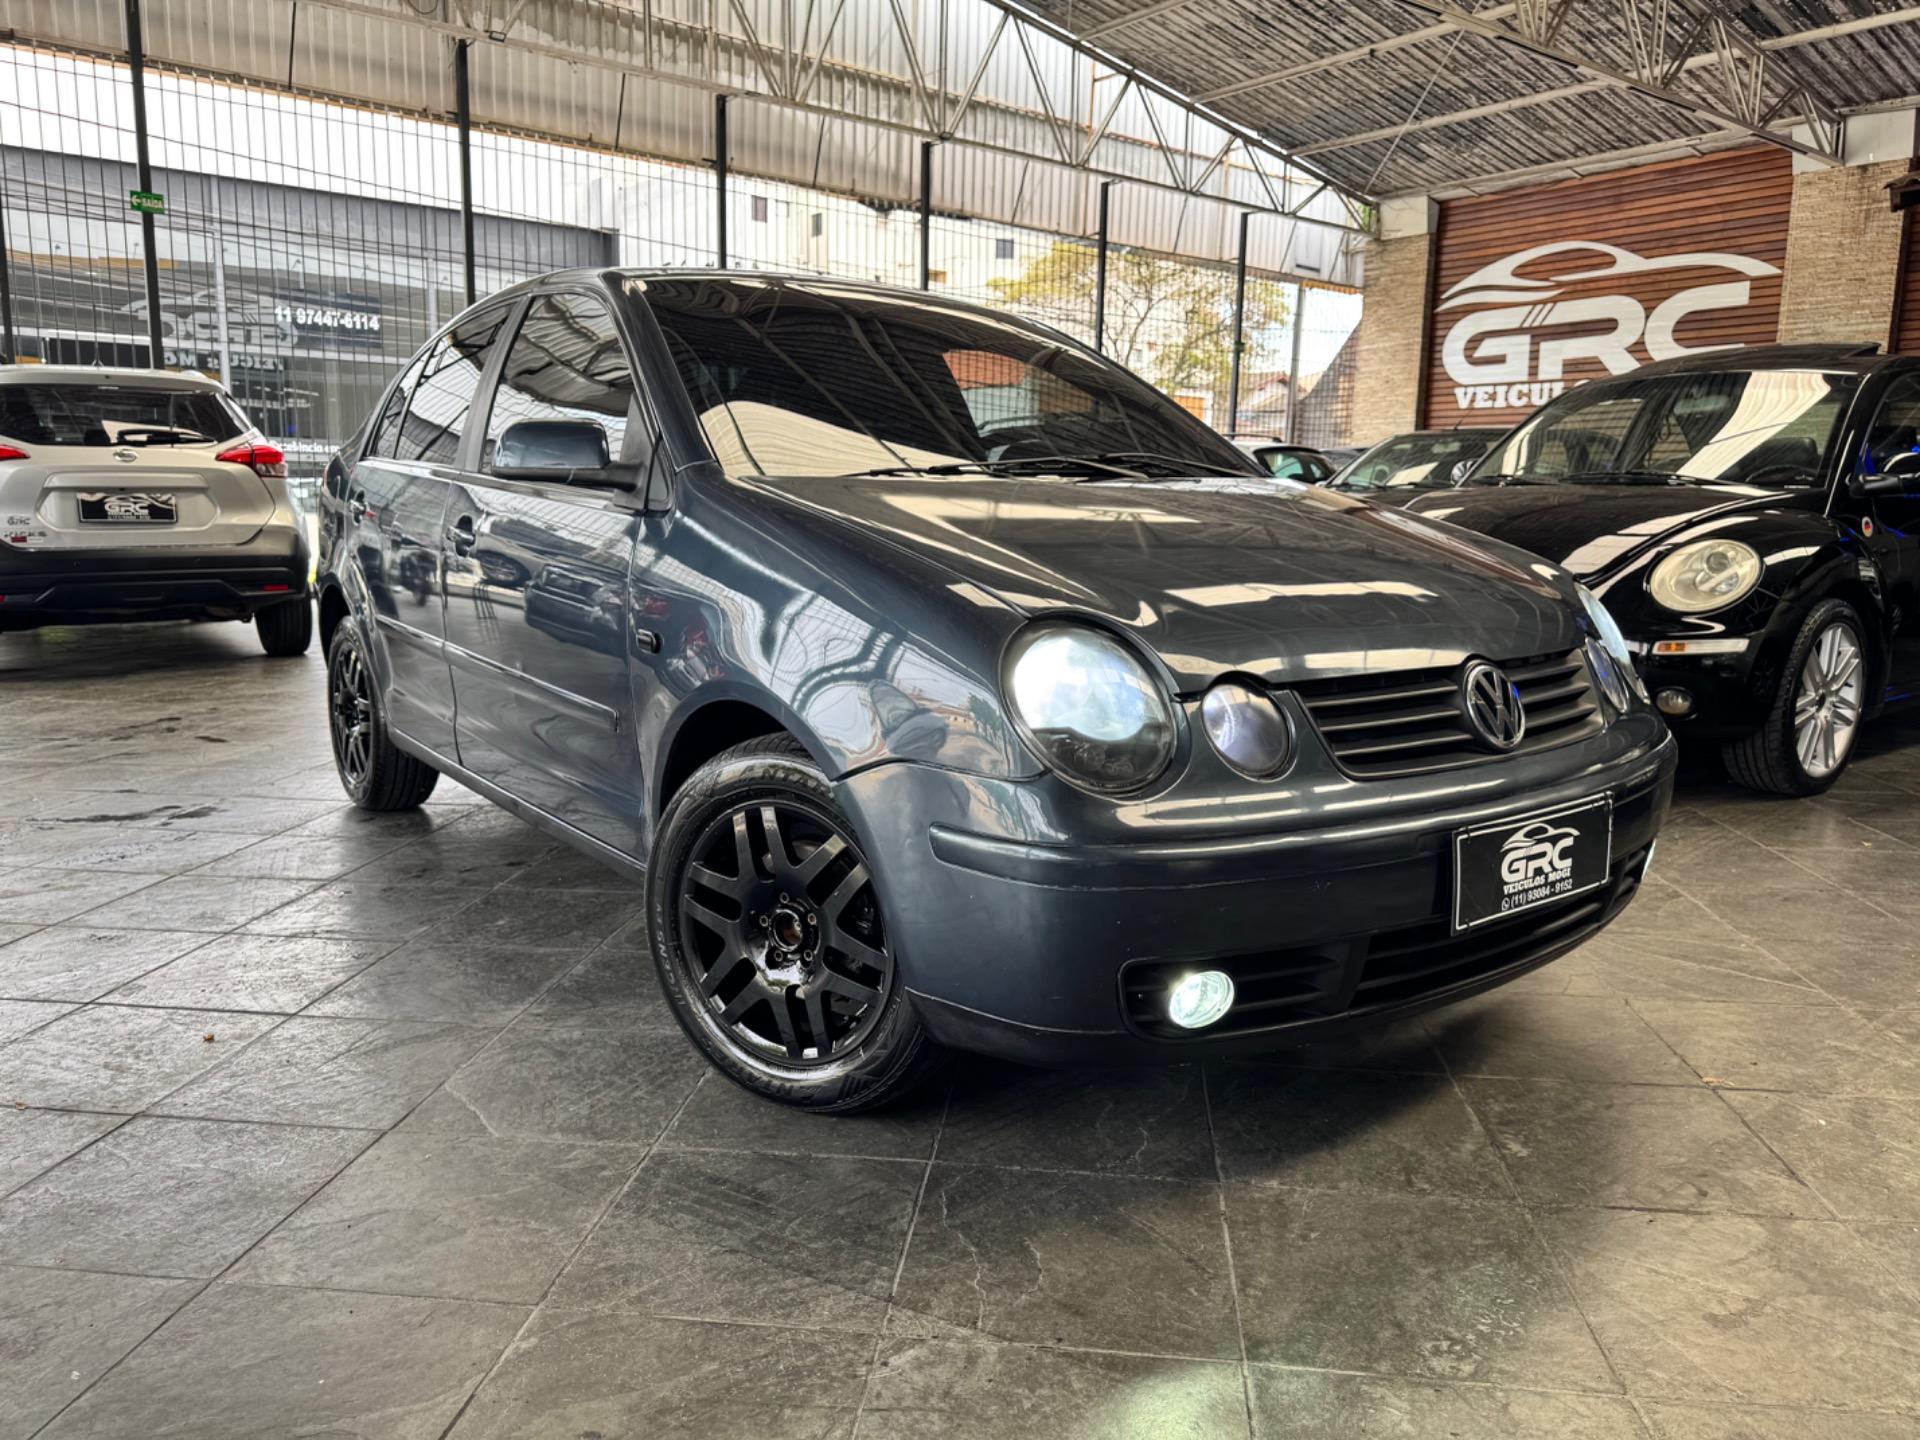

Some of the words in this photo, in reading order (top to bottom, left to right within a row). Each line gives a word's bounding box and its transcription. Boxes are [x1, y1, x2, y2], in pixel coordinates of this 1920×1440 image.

[1443, 280, 1750, 386] GRC
[104, 502, 149, 514] GRC
[1501, 835, 1574, 883] GRC
[1503, 874, 1546, 895] VEICULOS
[1547, 867, 1571, 883] MOGI
